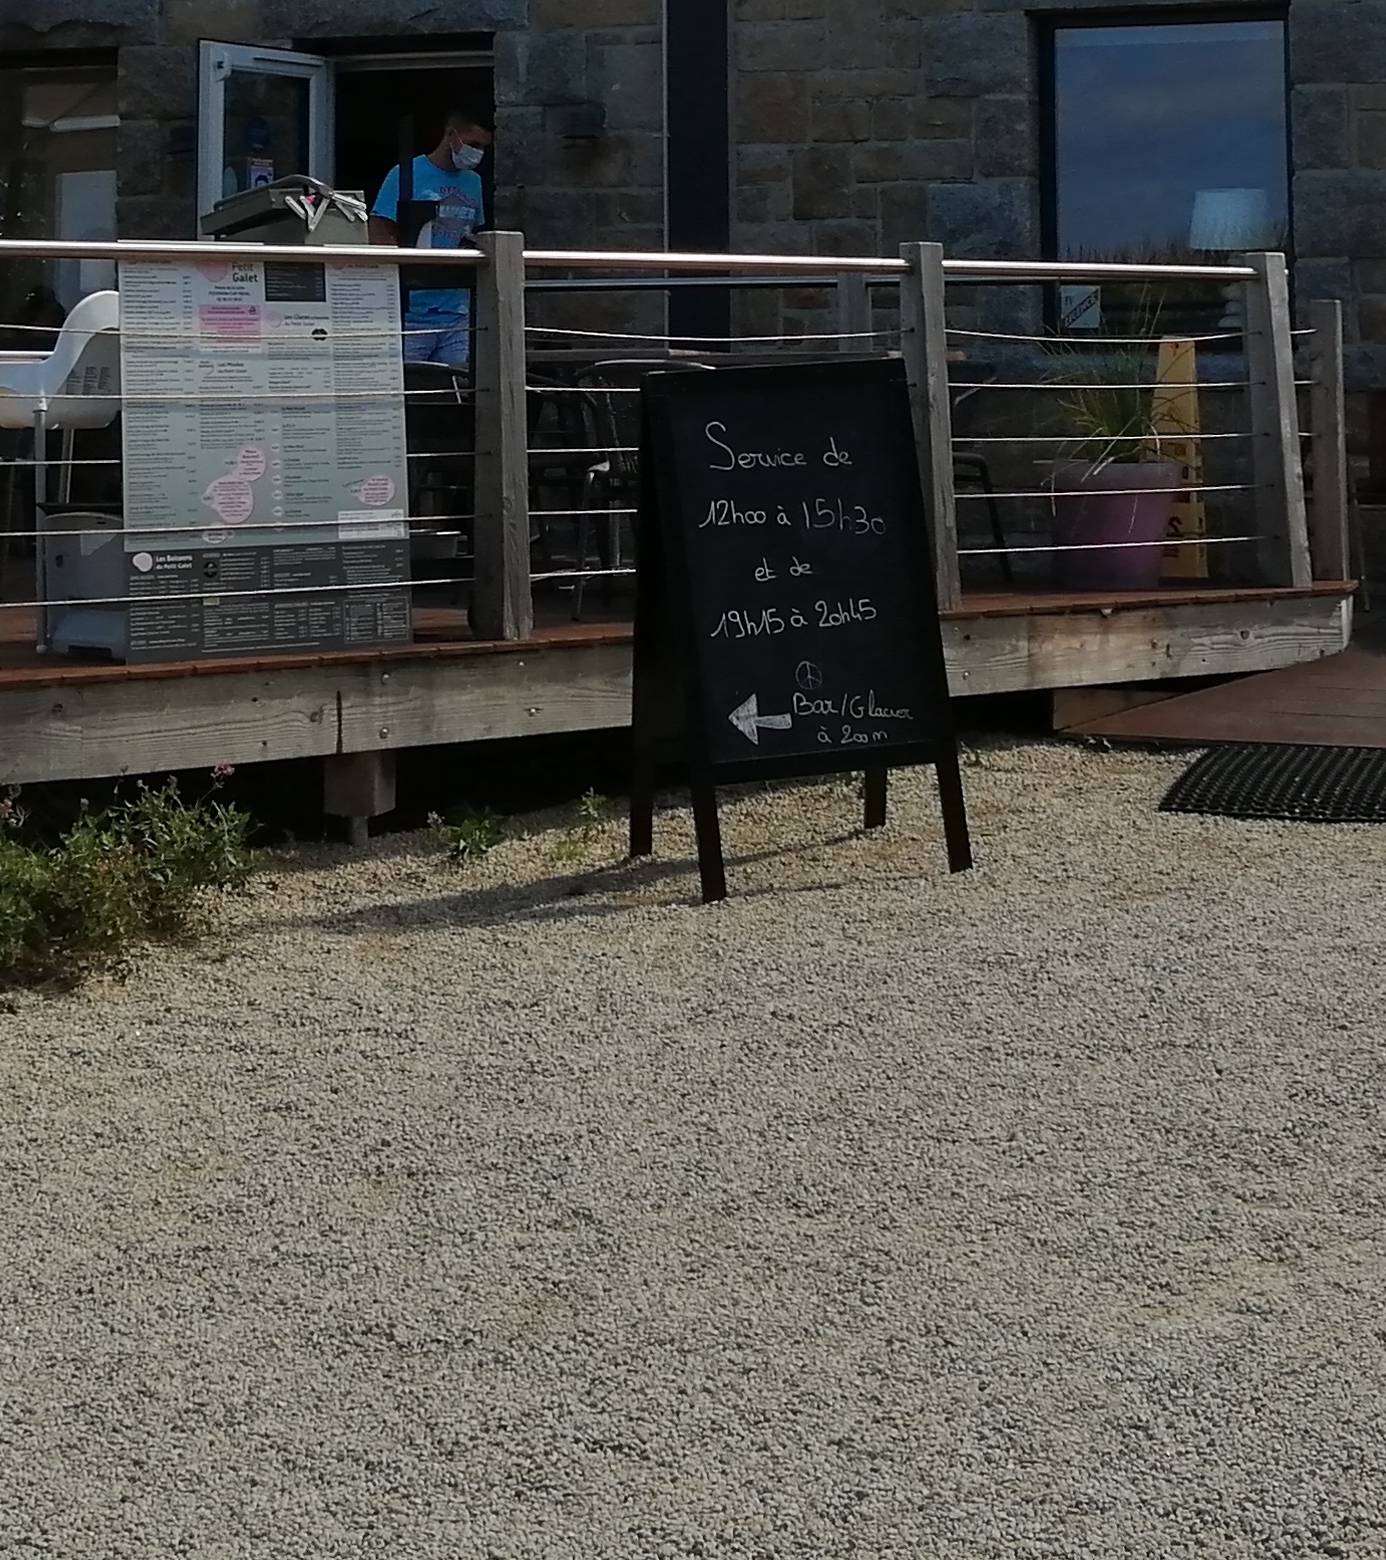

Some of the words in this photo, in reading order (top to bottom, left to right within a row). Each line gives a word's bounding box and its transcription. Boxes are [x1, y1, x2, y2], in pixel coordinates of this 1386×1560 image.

[232, 273, 259, 283] Galet
[705, 421, 807, 471] Service
[822, 436, 853, 466] de
[776, 505, 792, 526] à
[802, 498, 887, 535] 15h30
[754, 557, 778, 582] et
[789, 556, 813, 577] de
[710, 607, 785, 638] 19h15
[790, 608, 809, 628] à
[814, 598, 877, 628] 20h45
[817, 725, 832, 743] à
